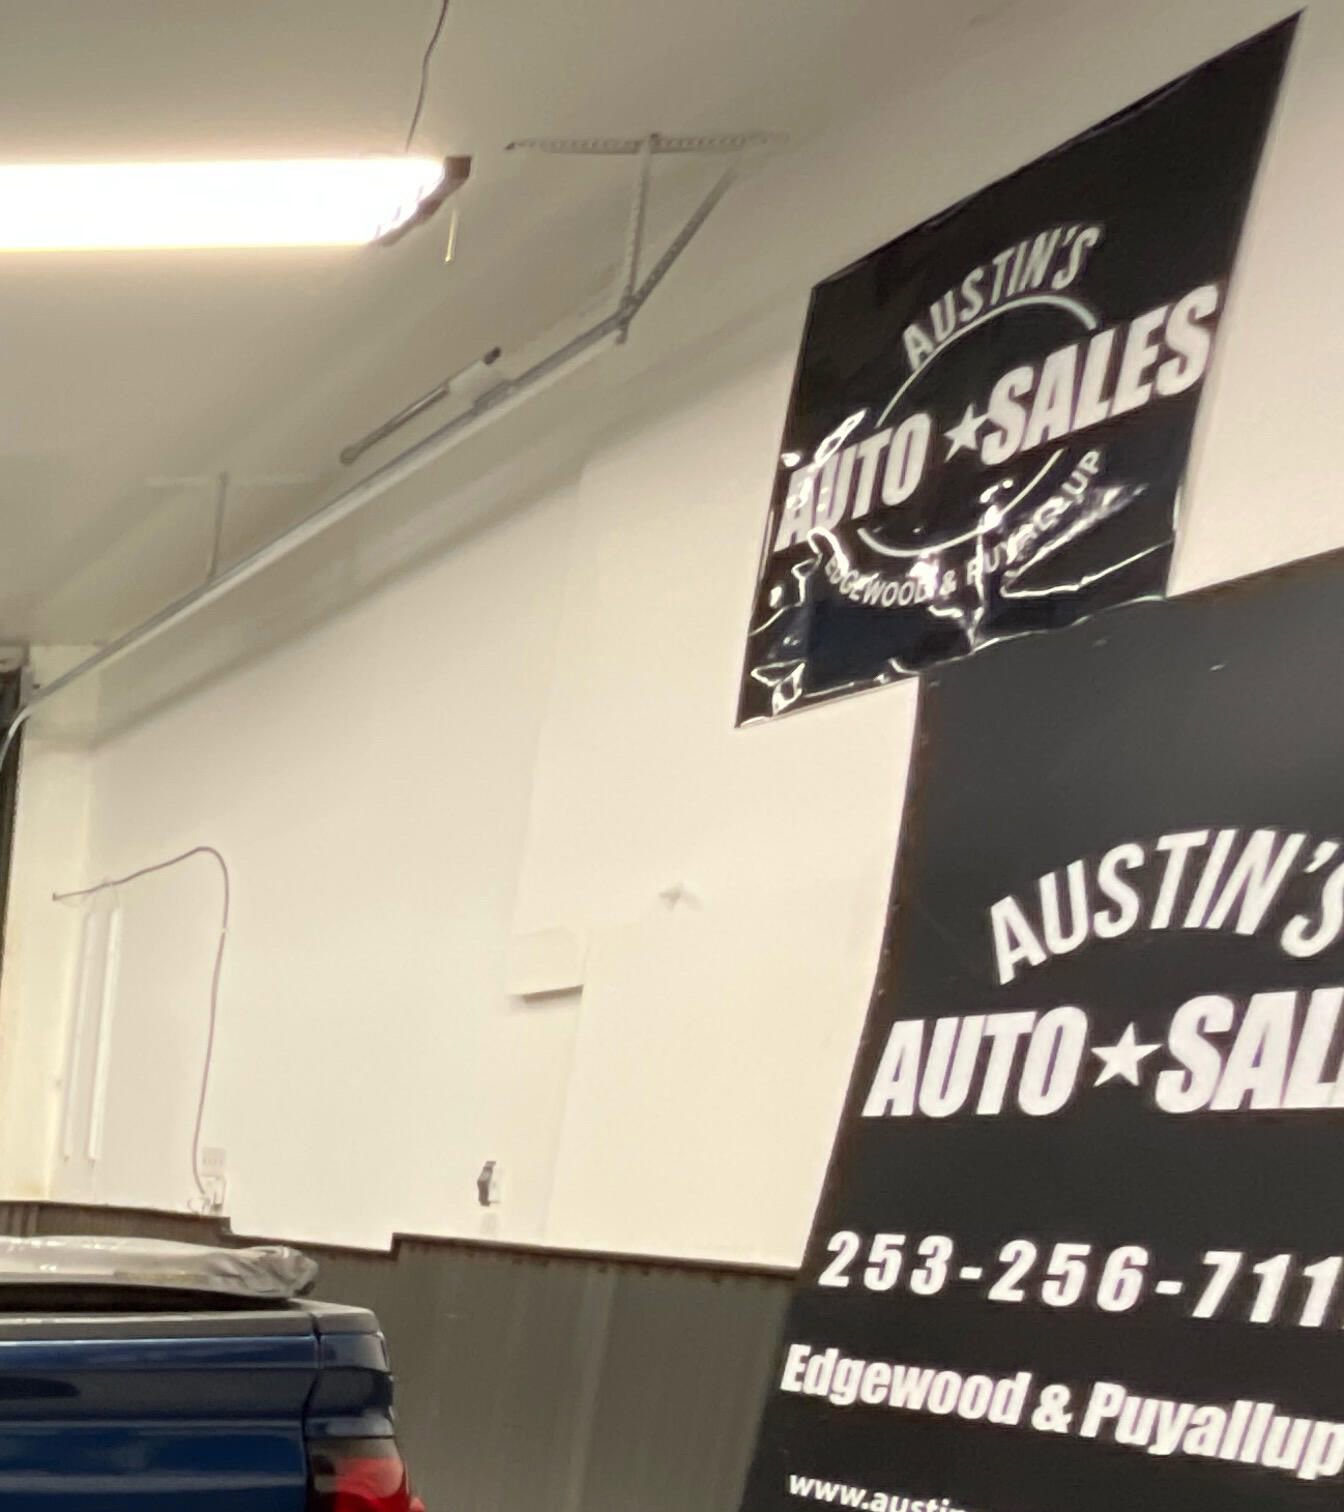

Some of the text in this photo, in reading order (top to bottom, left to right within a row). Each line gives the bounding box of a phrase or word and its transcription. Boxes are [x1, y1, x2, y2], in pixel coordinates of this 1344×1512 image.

[902, 223, 1103, 369] AUSTIN'S
[774, 284, 1219, 552] AUTO SALES
[862, 987, 1344, 1118] AUTO SAL
[818, 1232, 1344, 1328] 253-256-711
[780, 1344, 1344, 1480] Edgewood & Puyallup
